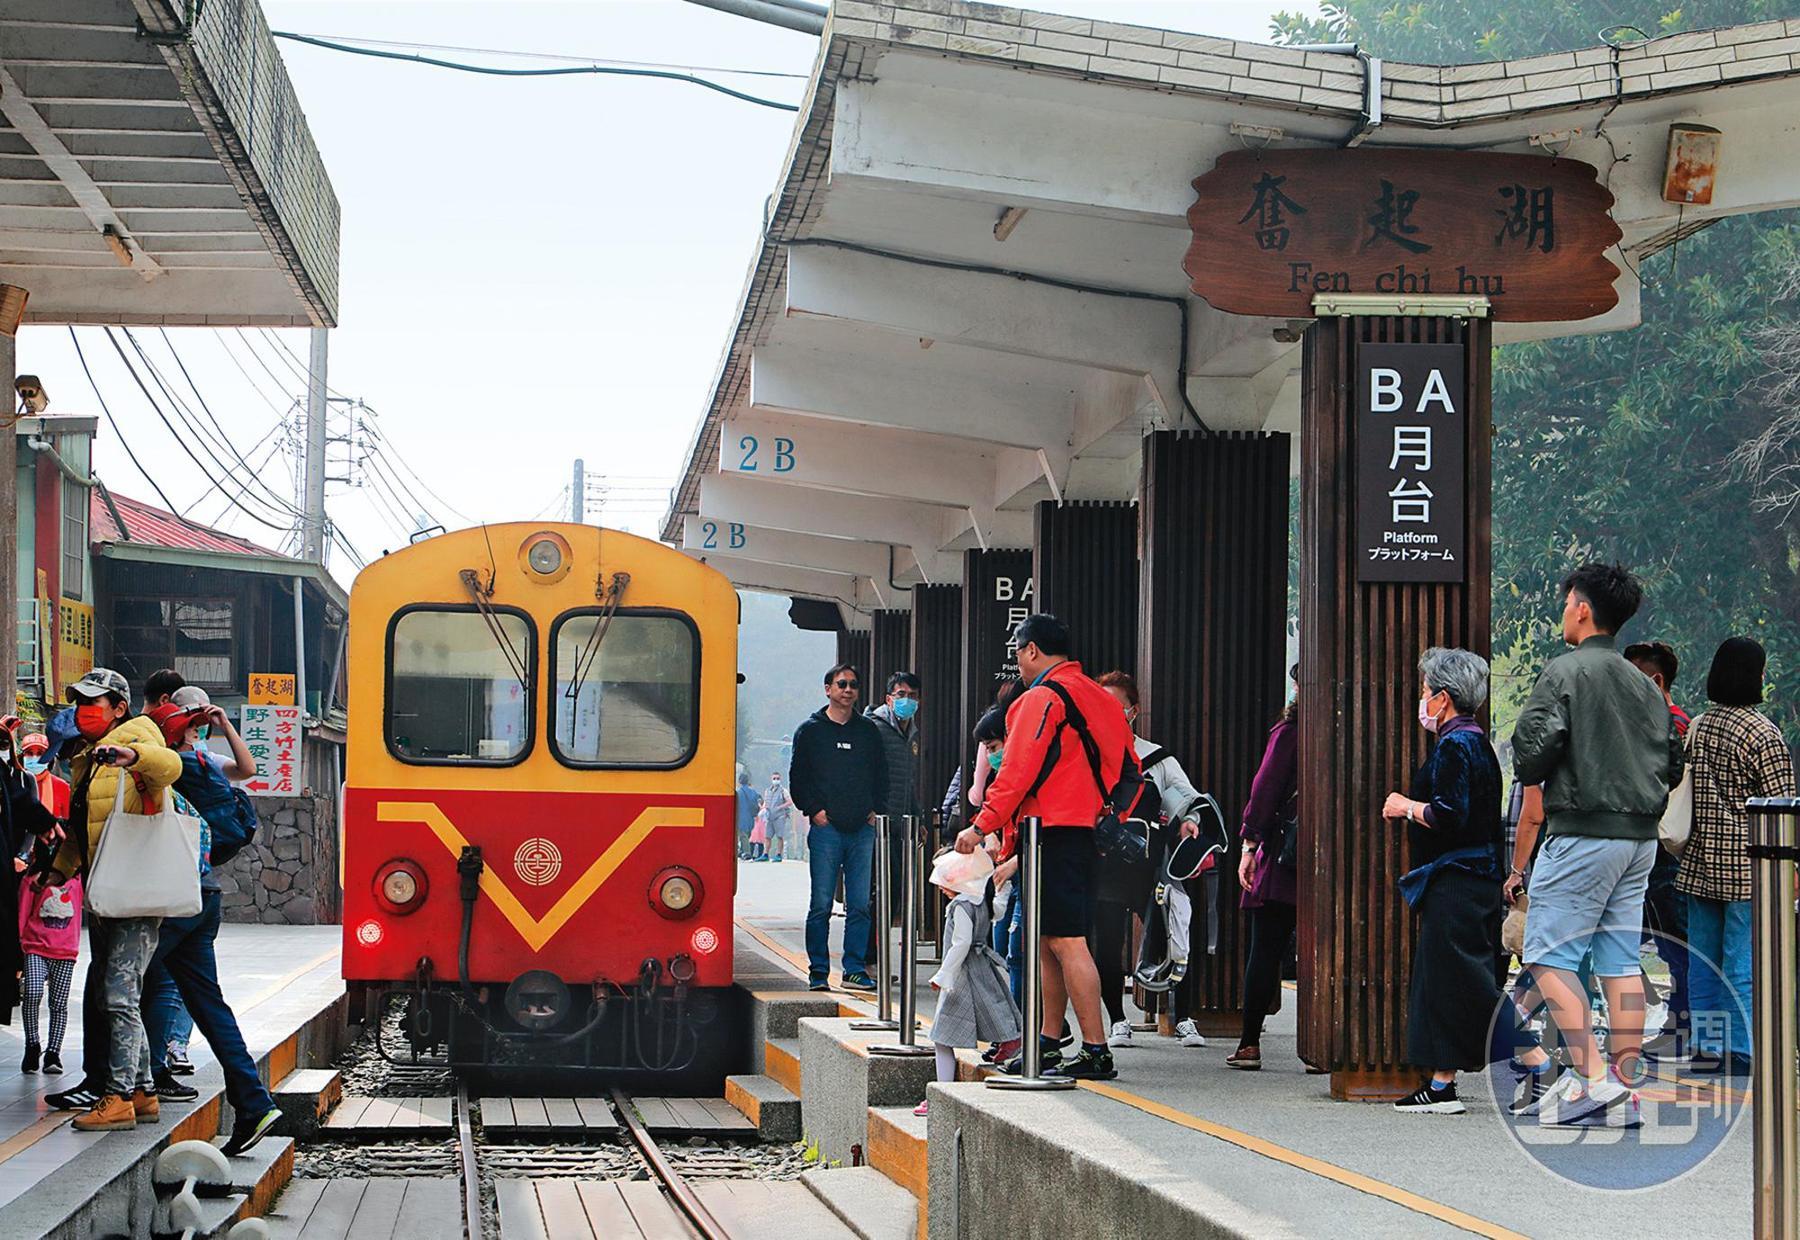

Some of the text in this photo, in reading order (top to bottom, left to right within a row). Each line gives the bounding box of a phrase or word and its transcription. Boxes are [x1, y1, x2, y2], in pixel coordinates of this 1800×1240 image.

[1238, 172, 1555, 253] 奮起湖
[1287, 262, 1505, 296] Fen chi hu
[739, 436, 796, 472] 2 B
[1388, 426, 1434, 523] 月台
[702, 521, 746, 549] 2 B
[1383, 531, 1438, 543] Platform
[1368, 547, 1455, 561] プラットフォーム
[250, 678, 293, 696] 奮起湖
